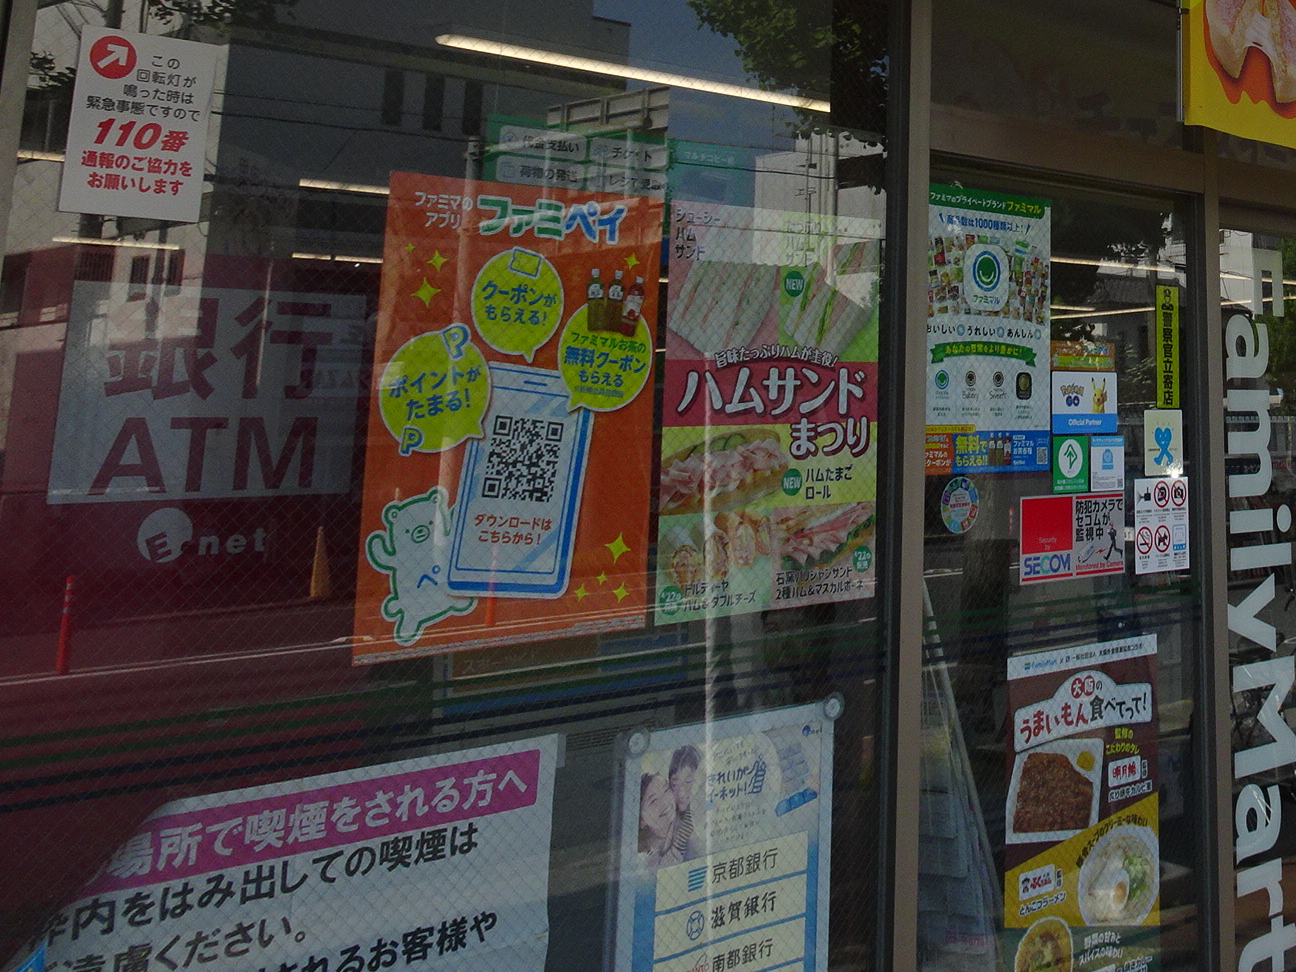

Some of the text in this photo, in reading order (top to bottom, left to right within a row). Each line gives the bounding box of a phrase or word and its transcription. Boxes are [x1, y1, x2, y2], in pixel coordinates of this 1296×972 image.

[151, 55, 181, 70] この
[136, 68, 197, 88] 回転灯が
[123, 83, 195, 105] 鳴った時は
[86, 95, 200, 122] 緊急事態ですので
[94, 117, 190, 153] 110番
[81, 149, 193, 178] 通報のご協力を
[87, 171, 184, 196] お願いします
[415, 191, 473, 212] ファミマの
[425, 212, 462, 229] アプリ
[478, 196, 626, 243] ファミペイ
[675, 227, 697, 241] ハム
[674, 244, 706, 261] サンド
[482, 280, 557, 309] クーポンが
[786, 278, 804, 291] NEW
[570, 331, 646, 354] ファミマルお茶の
[967, 325, 996, 336] うれしい
[1007, 328, 1034, 339] あんしん
[103, 294, 334, 400] 銀行
[714, 344, 838, 368] 旨味たっぷりハムが主役!
[564, 345, 647, 374] 無料クーポン
[389, 364, 481, 398] ポイントが
[578, 369, 624, 388] もらえる
[677, 367, 866, 416] ハムサンド
[1065, 395, 1080, 407] GO
[406, 388, 471, 421] たまる!
[791, 417, 868, 456] まつり
[956, 435, 987, 454] 無料で
[87, 417, 318, 495] ATM
[783, 477, 801, 489] NEW
[805, 464, 853, 482] ハムたまご
[805, 484, 832, 500] ロール
[1075, 498, 1123, 515] 防犯カメラで
[474, 513, 552, 530] ダウンロードは
[1076, 512, 1111, 527] セコムが
[1075, 527, 1104, 542] 監視中
[1024, 553, 1071, 576] SECOM
[1071, 676, 1103, 697] 大阪の
[1020, 692, 1147, 744] うまいもん食べてって!
[711, 847, 779, 884] 京都銀行
[711, 891, 777, 929] 滋賀銀行
[1019, 891, 1067, 916] とんこつラーメン
[712, 938, 774, 972] 南都銀行
